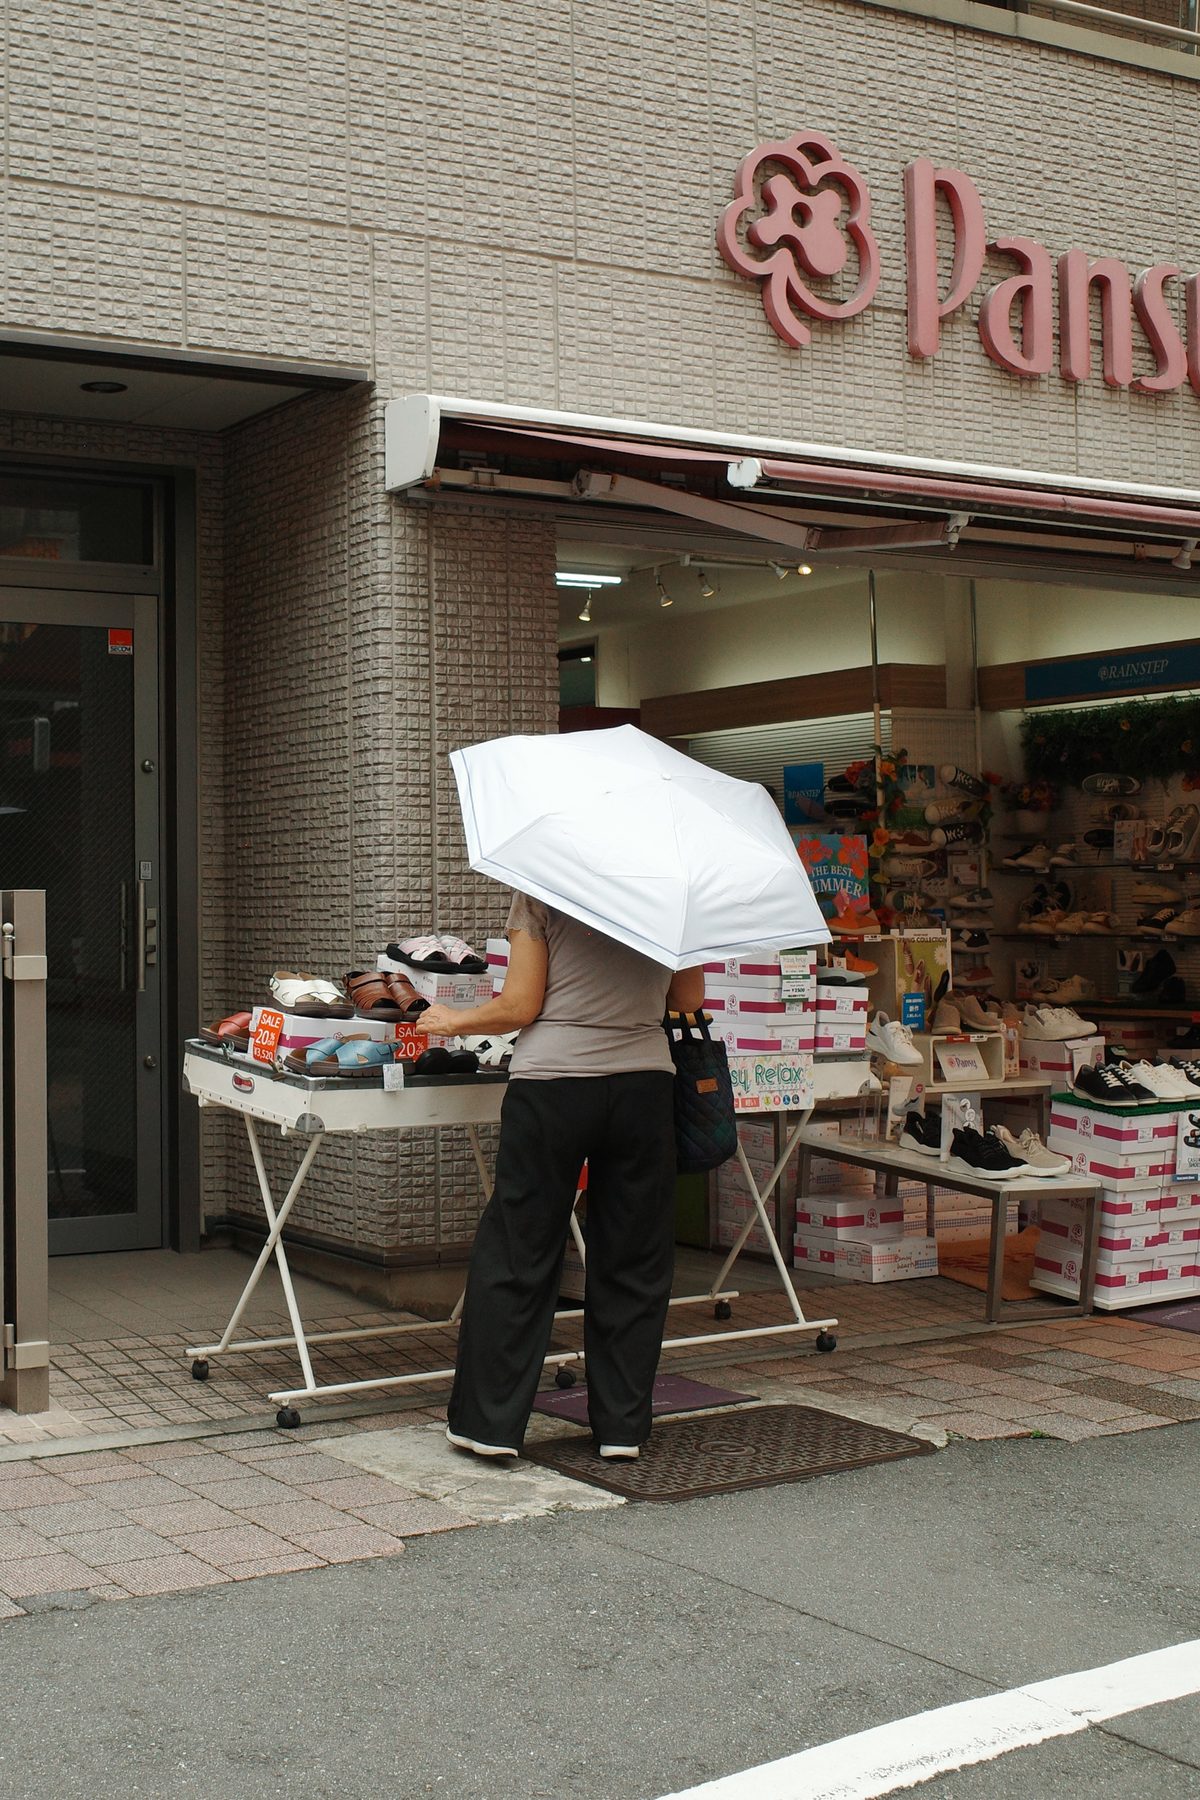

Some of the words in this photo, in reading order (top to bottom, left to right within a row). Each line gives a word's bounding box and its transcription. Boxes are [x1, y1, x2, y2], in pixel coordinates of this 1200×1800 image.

[904, 156, 1200, 397] Pans
[1108, 659, 1168, 679] RAINSTEP
[831, 865, 854, 877] BEST
[810, 878, 862, 898] UMMER
[916, 936, 948, 944] COLLECTION
[260, 1013, 282, 1029] SALE
[754, 1063, 804, 1086] Relax
